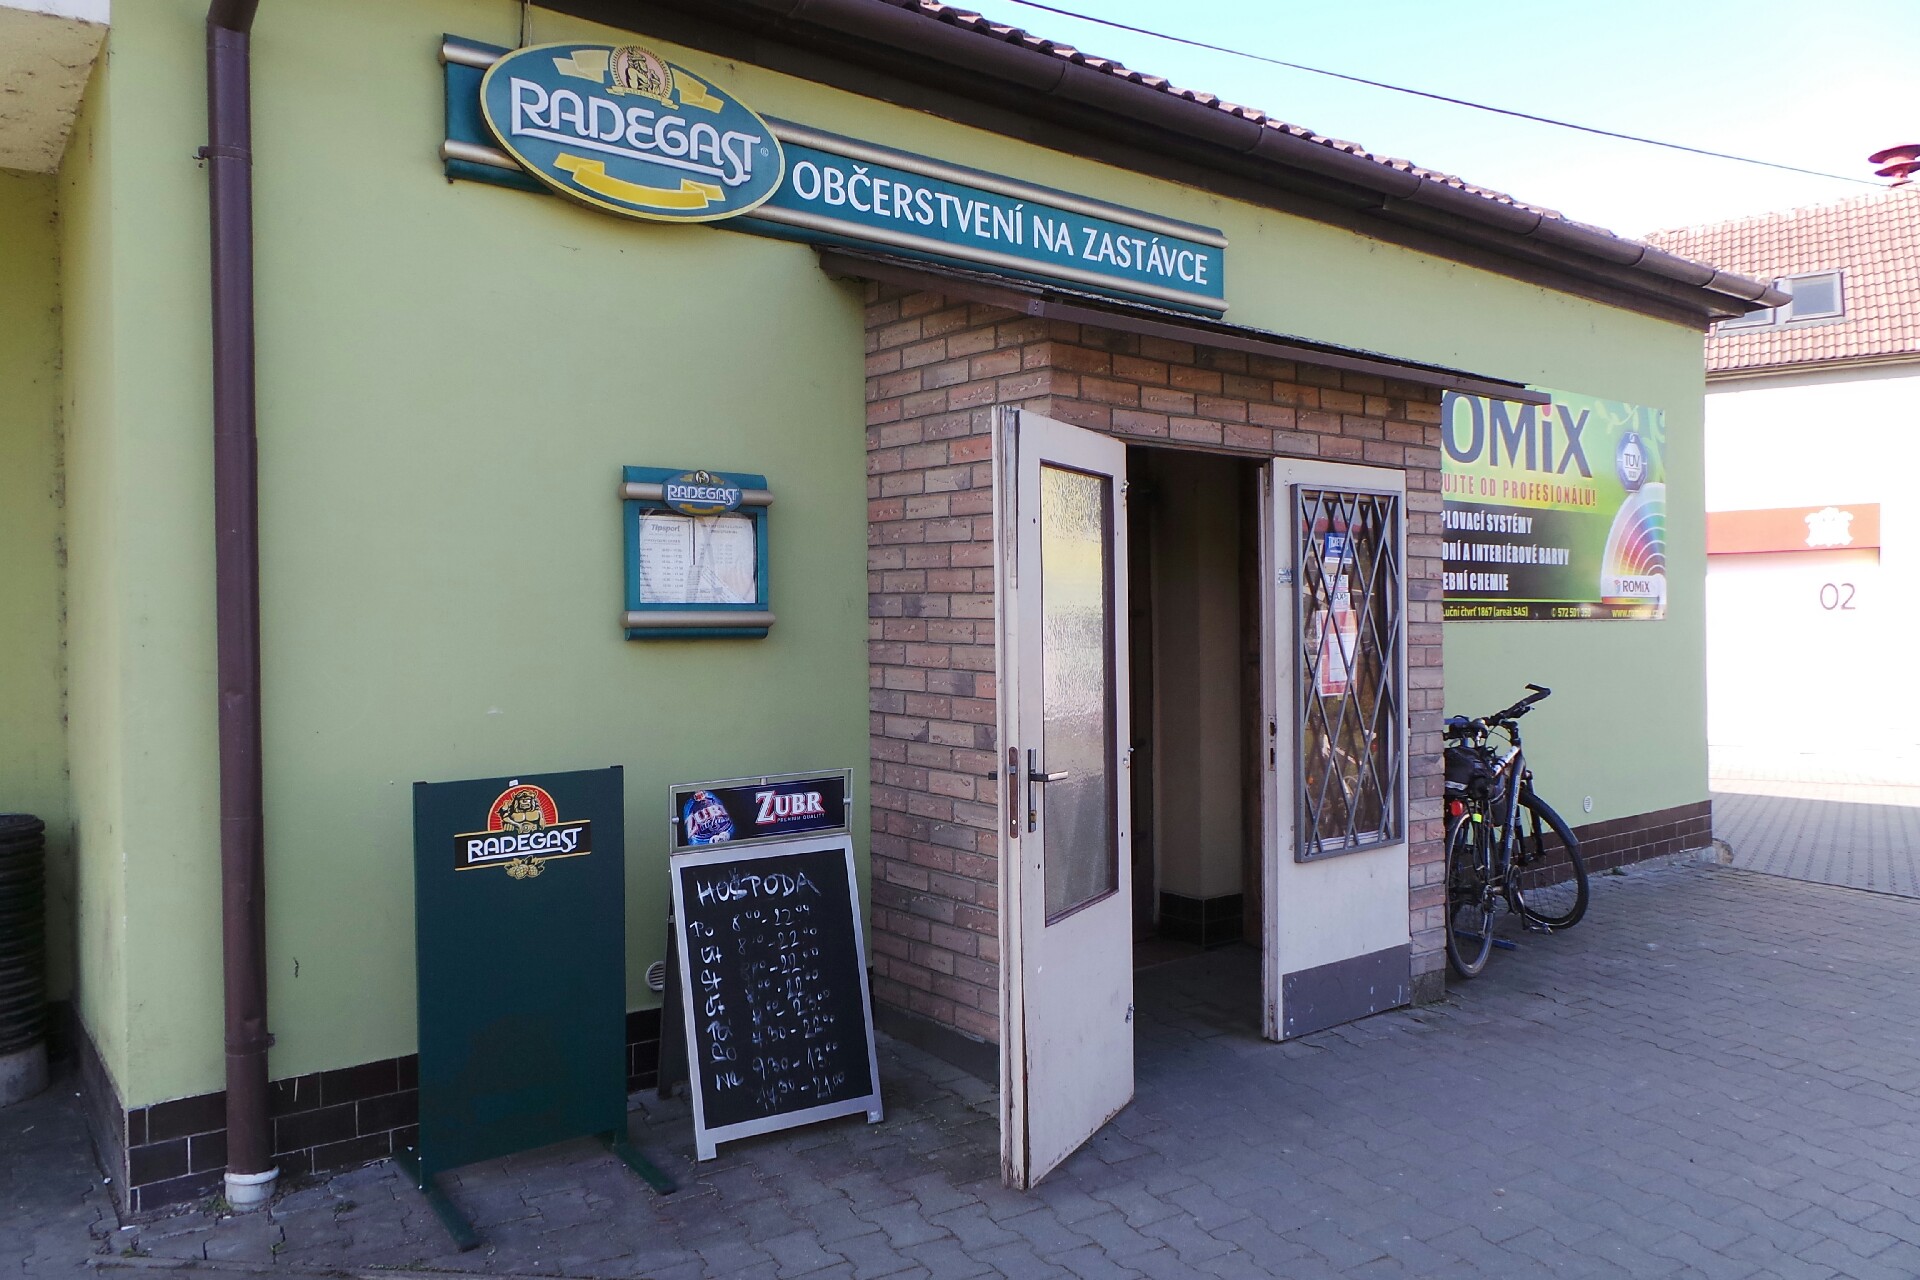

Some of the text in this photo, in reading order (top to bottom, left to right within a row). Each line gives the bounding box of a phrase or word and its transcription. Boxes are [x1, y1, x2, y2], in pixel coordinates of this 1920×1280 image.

[510, 77, 760, 187] RADEGAST
[792, 160, 1209, 286] OBČERSTVENÍ NA ZASTÁVCE
[667, 484, 738, 506] RADEGAST
[1480, 477, 1497, 497] OD
[651, 523, 681, 534] Tipsport
[1486, 512, 1533, 534] SYSTÉMY
[1463, 542, 1471, 560] A
[1472, 542, 1537, 564] INTERIÉROVÉ
[1538, 547, 1570, 565] BARVY
[1469, 572, 1509, 591] CHEMIE
[755, 790, 825, 825] ZUBR
[467, 827, 583, 864] RADEGAST
